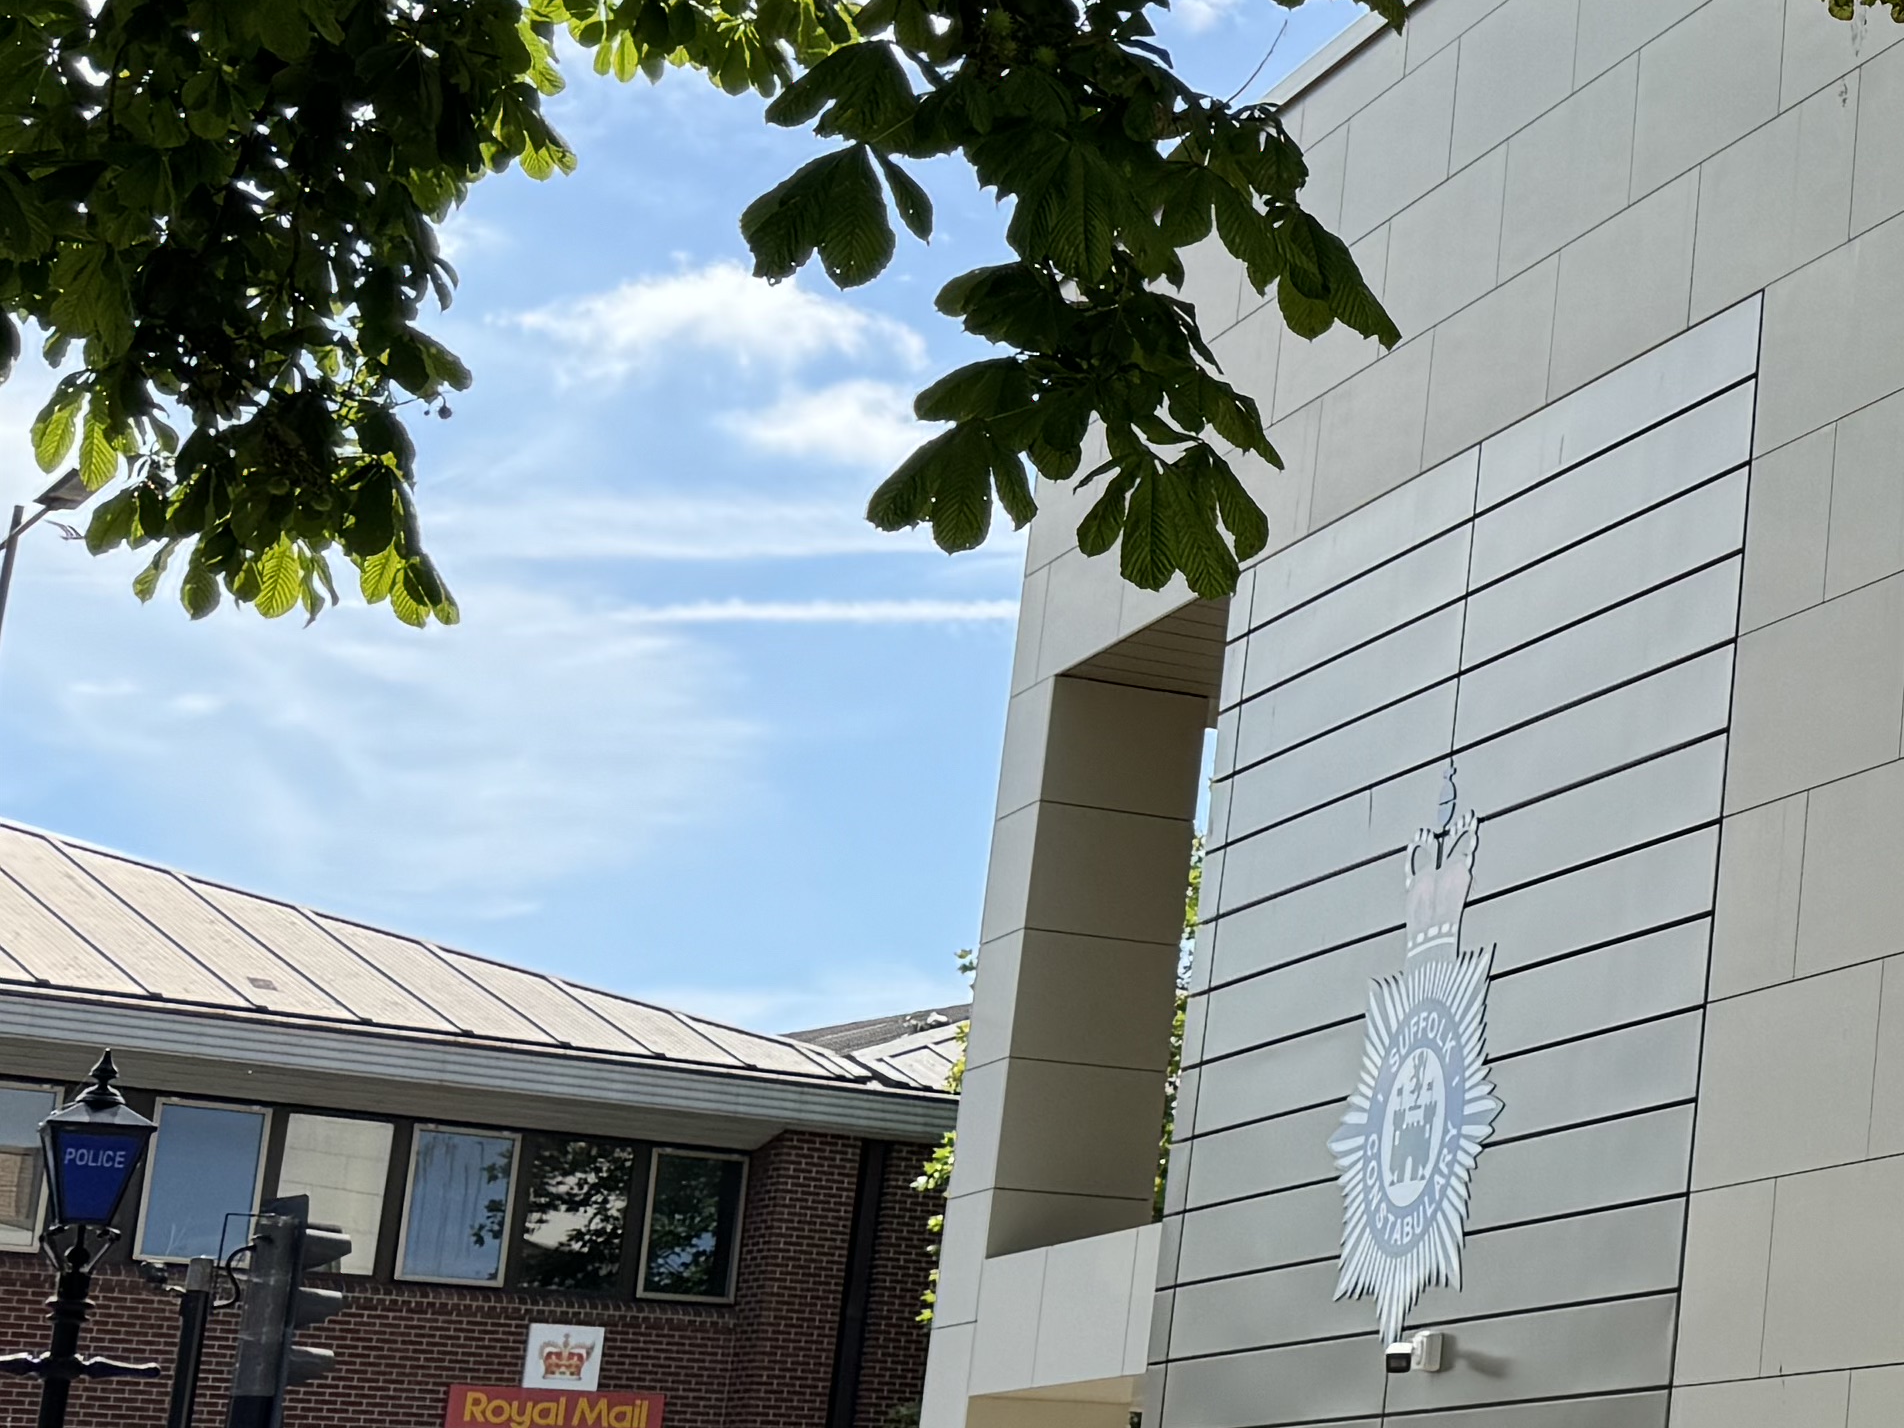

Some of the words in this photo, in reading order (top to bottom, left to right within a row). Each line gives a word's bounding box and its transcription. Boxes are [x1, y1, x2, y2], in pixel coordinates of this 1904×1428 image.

[1388, 1011, 1456, 1073] SUFFOLK
[64, 1148, 126, 1168] POLICE
[1366, 1120, 1458, 1245] CONSTABULARY
[571, 1396, 649, 1428] Mail
